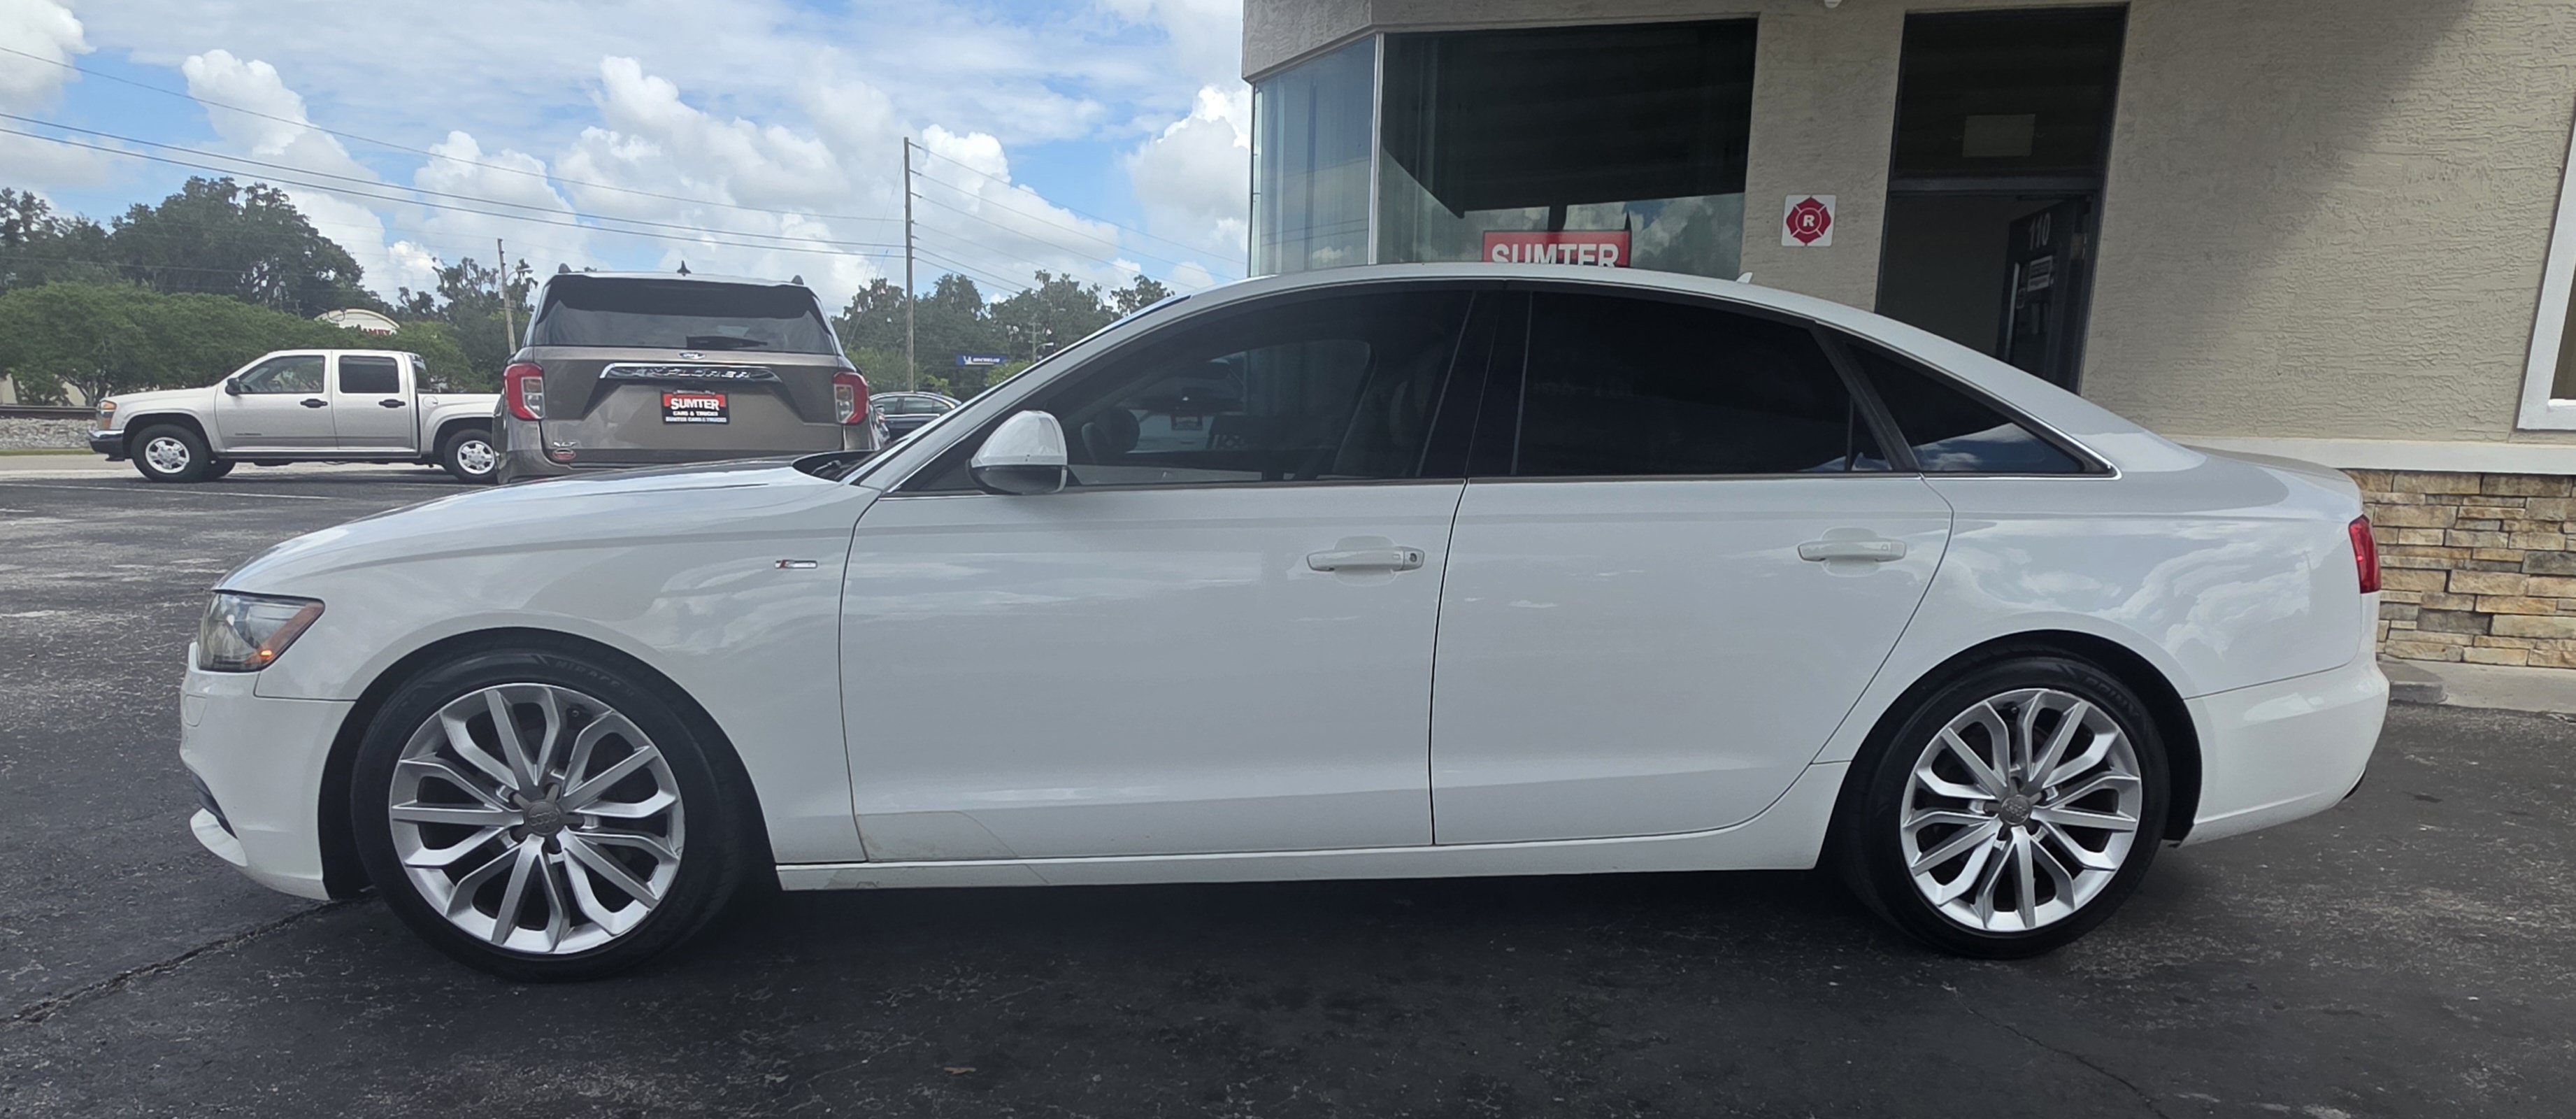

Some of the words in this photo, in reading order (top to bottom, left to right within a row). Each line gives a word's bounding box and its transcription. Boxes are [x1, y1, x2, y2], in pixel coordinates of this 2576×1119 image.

[1803, 215, 1815, 227] R
[2029, 212, 2051, 250] 110
[1491, 243, 1619, 267] SUMTER
[671, 398, 720, 411] SUMTER
